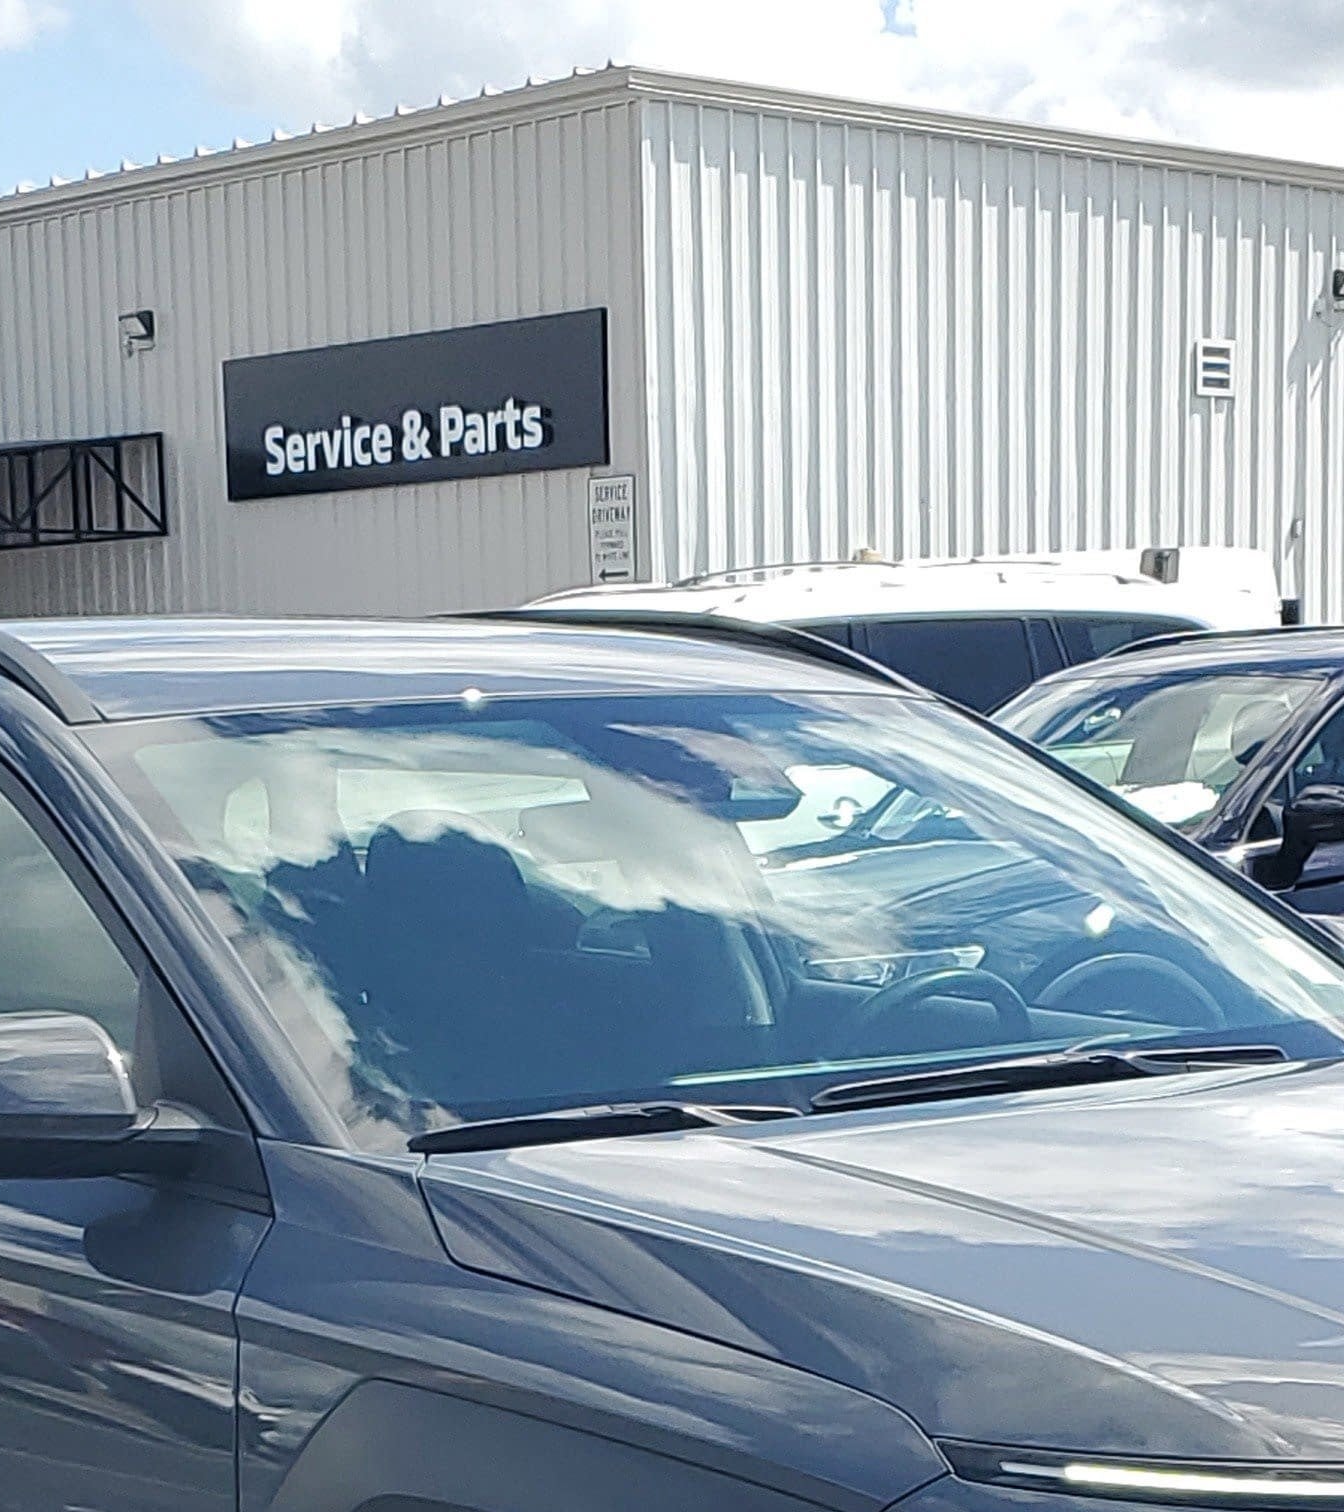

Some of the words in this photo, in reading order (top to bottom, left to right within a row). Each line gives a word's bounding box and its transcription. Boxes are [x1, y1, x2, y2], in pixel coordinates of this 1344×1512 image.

[264, 415, 392, 475] Service
[401, 410, 432, 461] &
[440, 397, 543, 457] Parts
[595, 484, 627, 502] SERVICE
